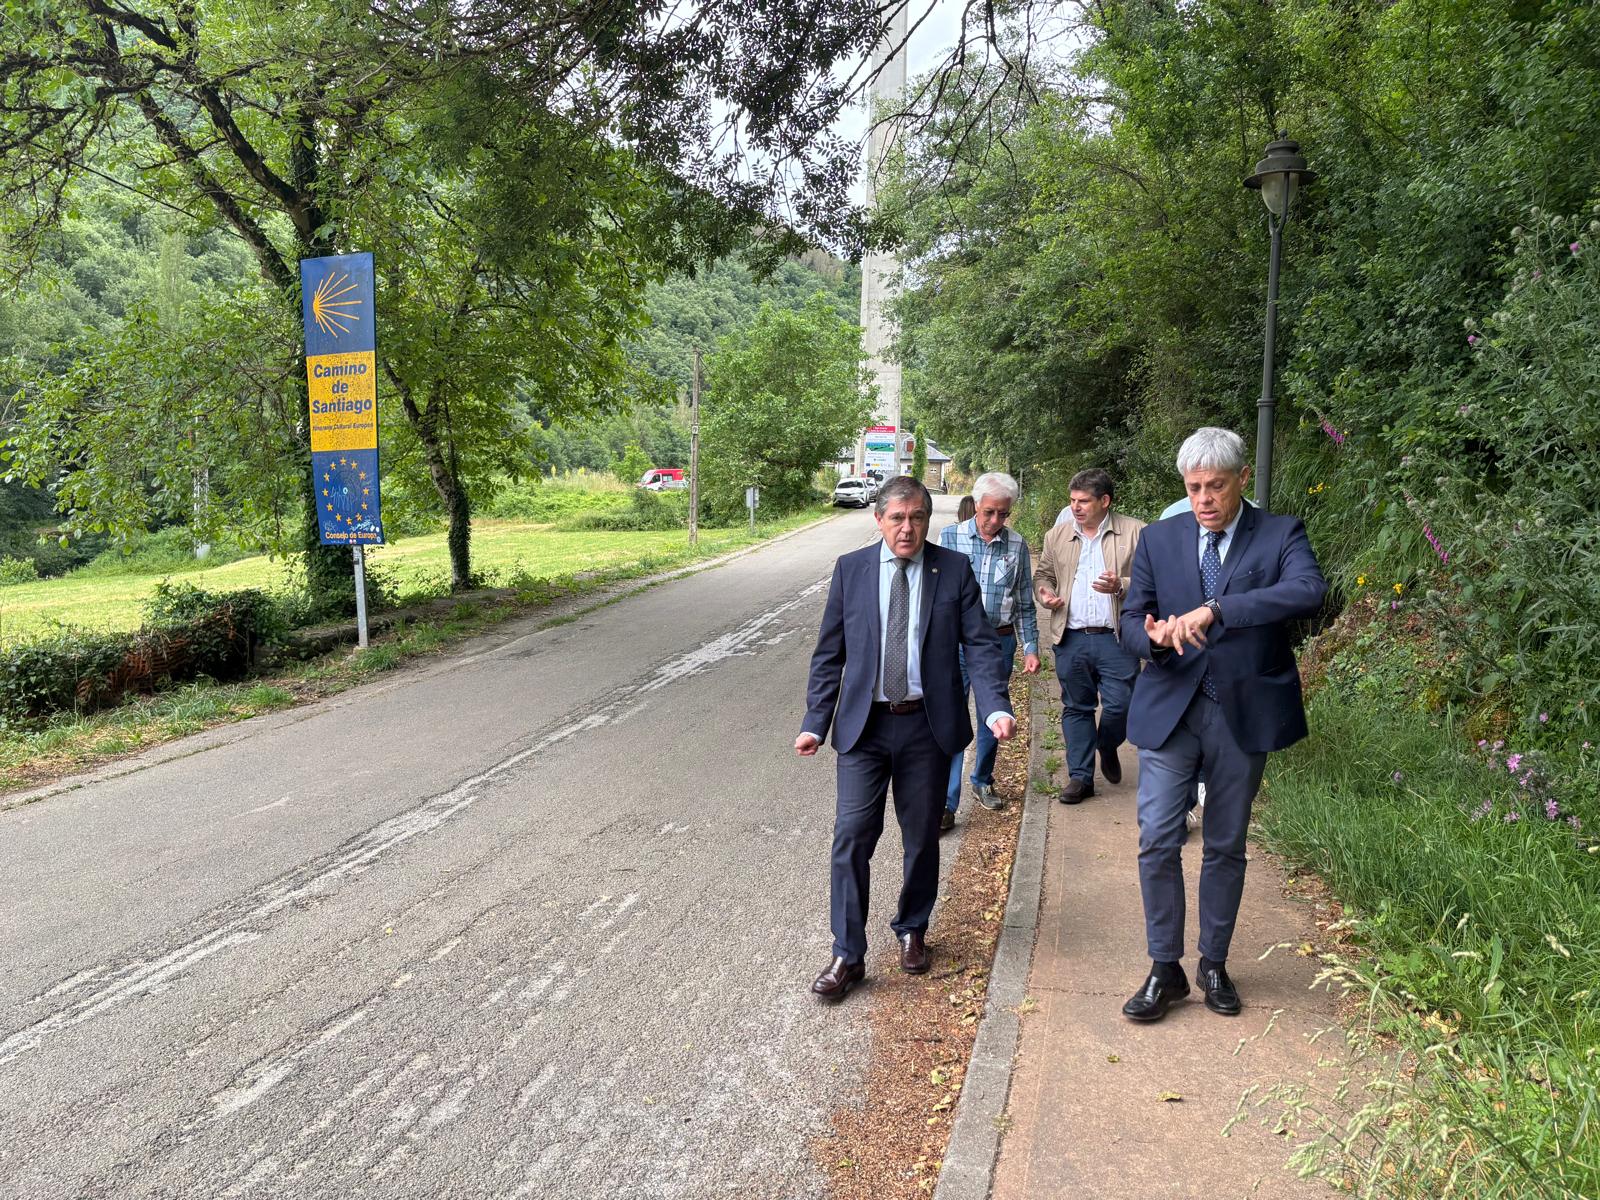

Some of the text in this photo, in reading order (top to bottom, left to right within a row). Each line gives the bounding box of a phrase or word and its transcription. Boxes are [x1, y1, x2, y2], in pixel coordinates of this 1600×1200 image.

[314, 361, 367, 378] Camino
[332, 380, 348, 394] de
[312, 397, 372, 414] Santiago
[325, 532, 348, 540] Consejo
